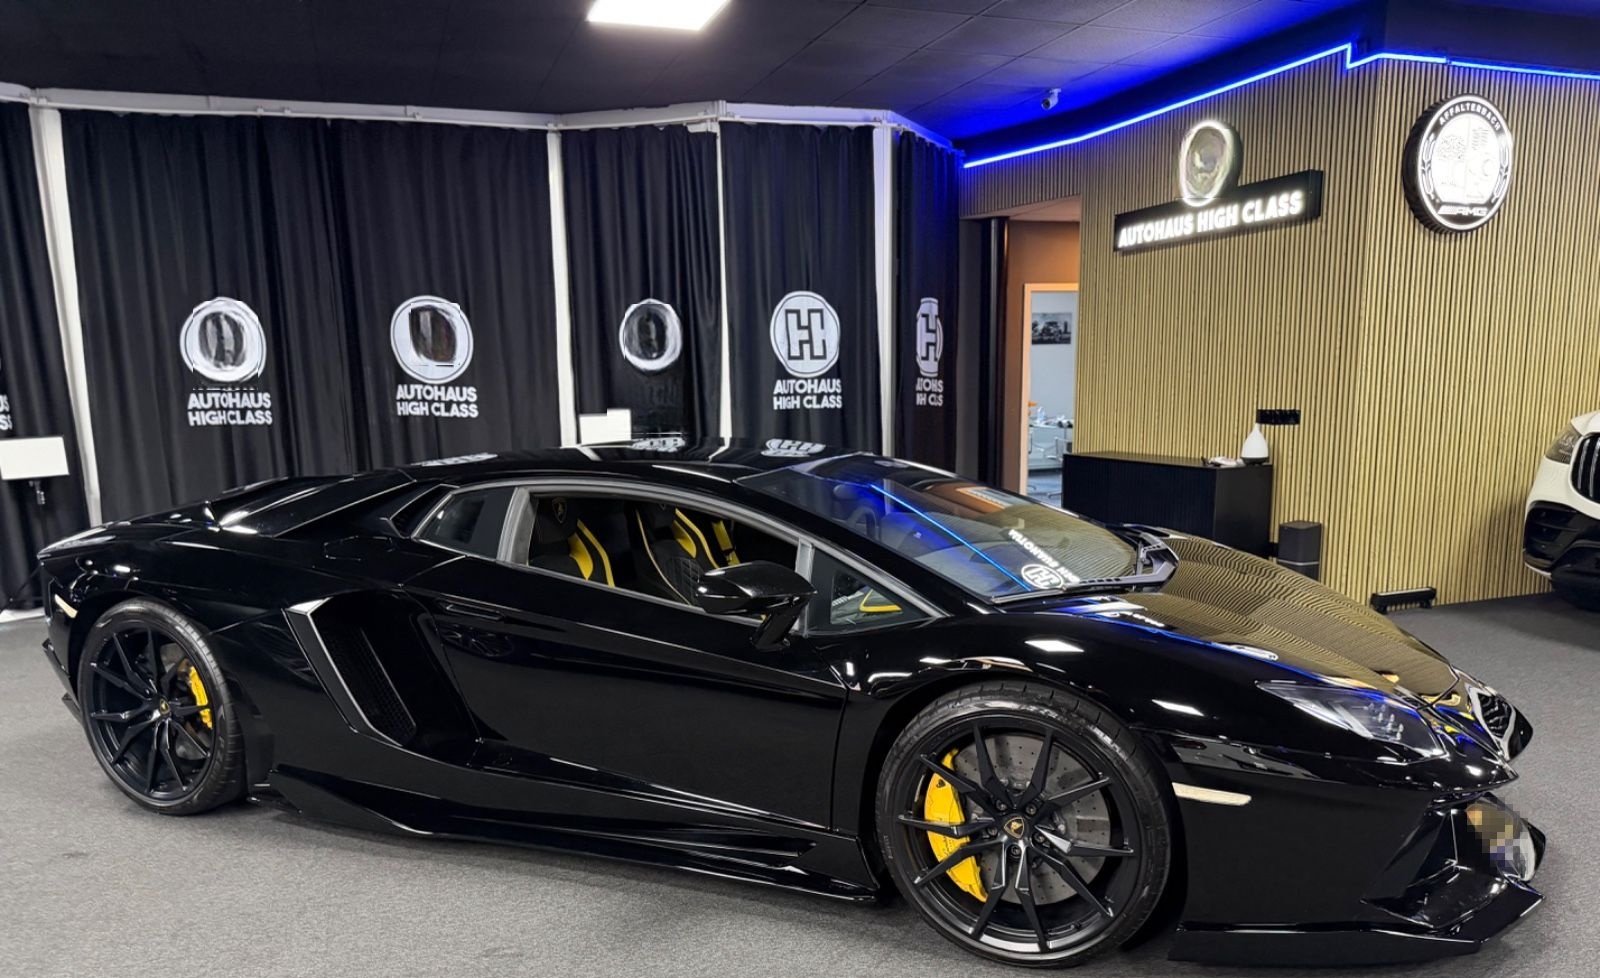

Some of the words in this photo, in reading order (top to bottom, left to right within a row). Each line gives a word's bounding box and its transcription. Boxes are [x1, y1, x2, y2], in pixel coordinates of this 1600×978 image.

[1439, 102, 1501, 131] AFFALTERBACH
[1117, 213, 1194, 248] AUTOHAUS
[1197, 203, 1239, 232] HIGH
[1242, 190, 1304, 223] CLASS
[396, 384, 478, 402] AUTOHAUS
[773, 378, 842, 394] AUTOHAUS
[187, 392, 272, 410] AUTOHAUS
[396, 401, 429, 416] HIGH
[431, 402, 479, 418] CLASS
[773, 396, 801, 410] HIGH
[803, 395, 843, 409] CLASS
